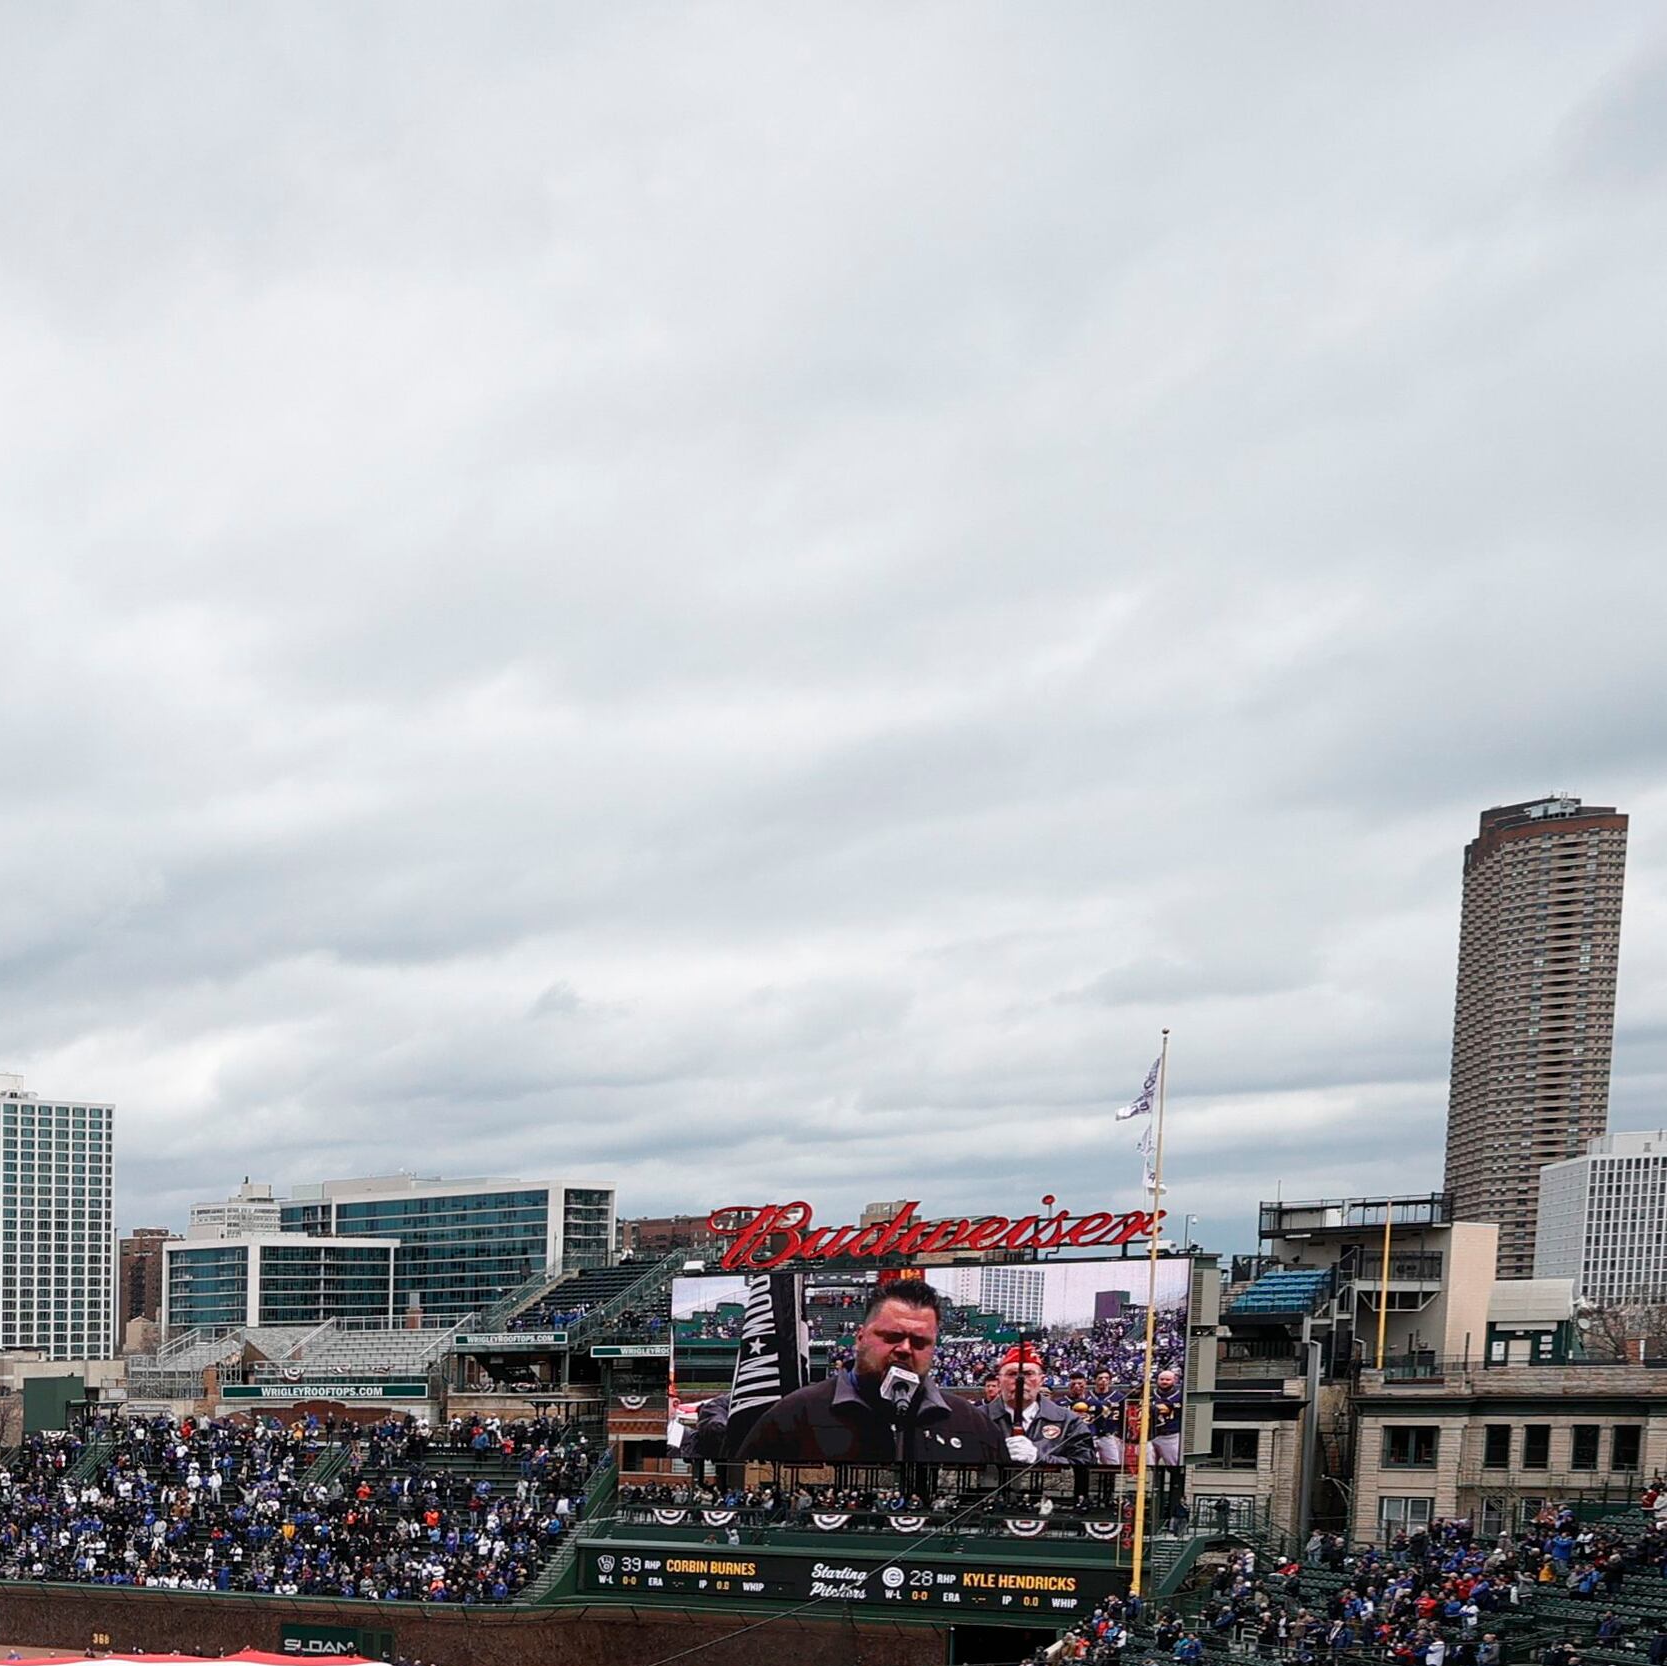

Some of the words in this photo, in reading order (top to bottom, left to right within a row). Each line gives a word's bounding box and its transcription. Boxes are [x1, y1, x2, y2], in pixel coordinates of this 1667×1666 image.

[707, 1195, 1167, 1270] Budweiser
[808, 1339, 836, 1347] dvocate
[261, 1387, 383, 1397] WRIGLEYROOFTOPS.COM
[728, 1353, 782, 1417] MIA
[621, 1557, 641, 1572] 39
[645, 1560, 661, 1570] RHP
[667, 1559, 708, 1574] CORBIN
[710, 1561, 756, 1576] BURNES
[811, 1563, 867, 1584] Starting
[598, 1575, 614, 1585] W-L
[622, 1576, 637, 1585] 0-0
[648, 1577, 663, 1587] ERA
[699, 1580, 707, 1589] IP
[717, 1581, 730, 1590] 0.0
[743, 1582, 764, 1592] WHIP
[910, 1570, 933, 1586] 28
[937, 1573, 956, 1584] RHP
[963, 1573, 996, 1588] KYLE
[999, 1575, 1077, 1591] HENDRICKS
[885, 1589, 902, 1599] W-L
[912, 1591, 928, 1600] 0-0
[943, 1592, 960, 1602] ERA
[1002, 1595, 1012, 1604] IP
[1023, 1596, 1039, 1606] 0.0
[1052, 1598, 1077, 1608] WHIP
[93, 1633, 109, 1645] 368
